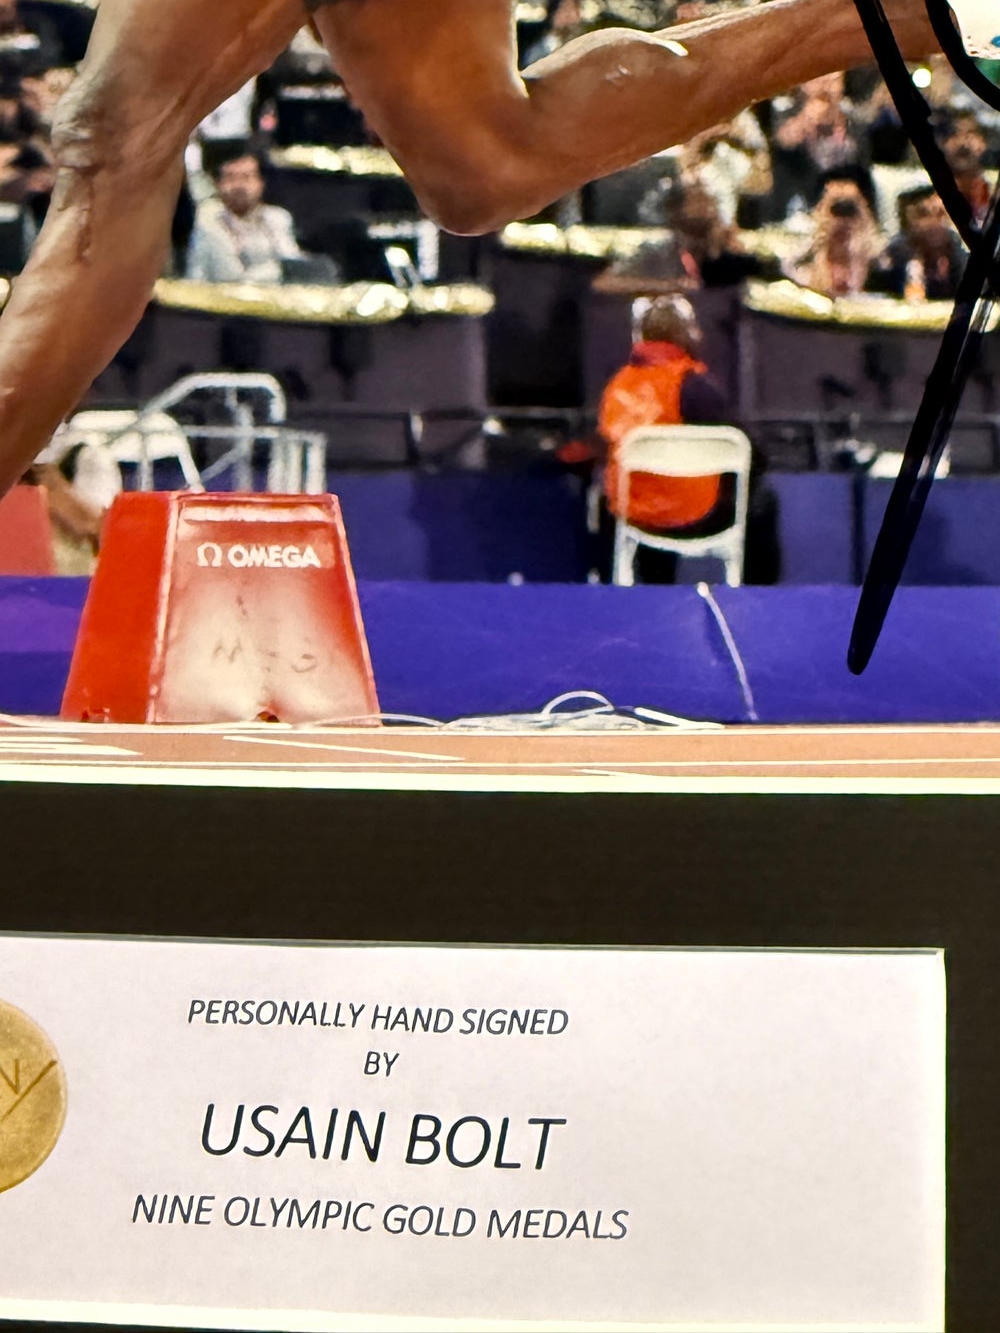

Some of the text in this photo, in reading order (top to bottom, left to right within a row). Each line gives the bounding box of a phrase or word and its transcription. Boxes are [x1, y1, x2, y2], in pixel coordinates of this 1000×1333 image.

[227, 543, 322, 569] OMEGA
[188, 999, 570, 1036] PERSONALLY HAND SIGNED
[363, 1050, 400, 1077] BY
[201, 1103, 567, 1171] USAIN BOLT
[132, 1194, 629, 1240] NINE OLYMPIC GOLD MEDALS
